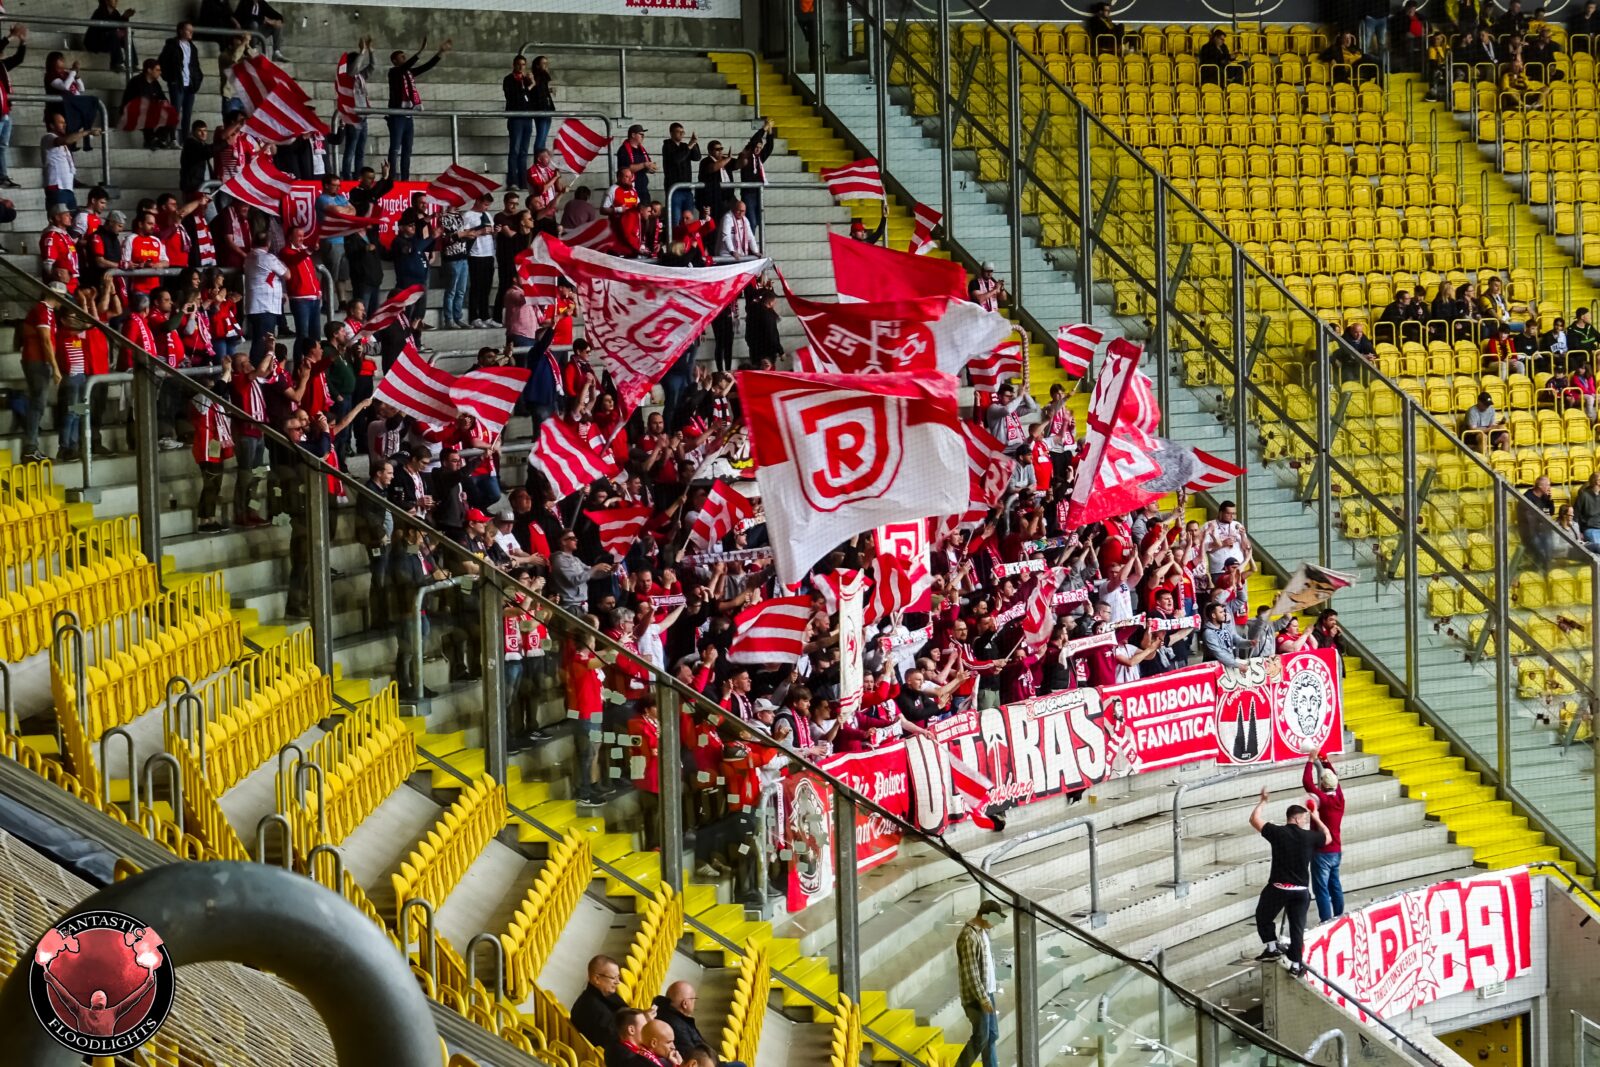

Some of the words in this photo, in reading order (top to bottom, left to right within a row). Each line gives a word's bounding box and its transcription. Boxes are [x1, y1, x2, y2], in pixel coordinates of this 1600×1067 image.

[1126, 682, 1215, 718] RATISBONA
[1137, 716, 1216, 751] FANATICA
[872, 770, 906, 804] Power
